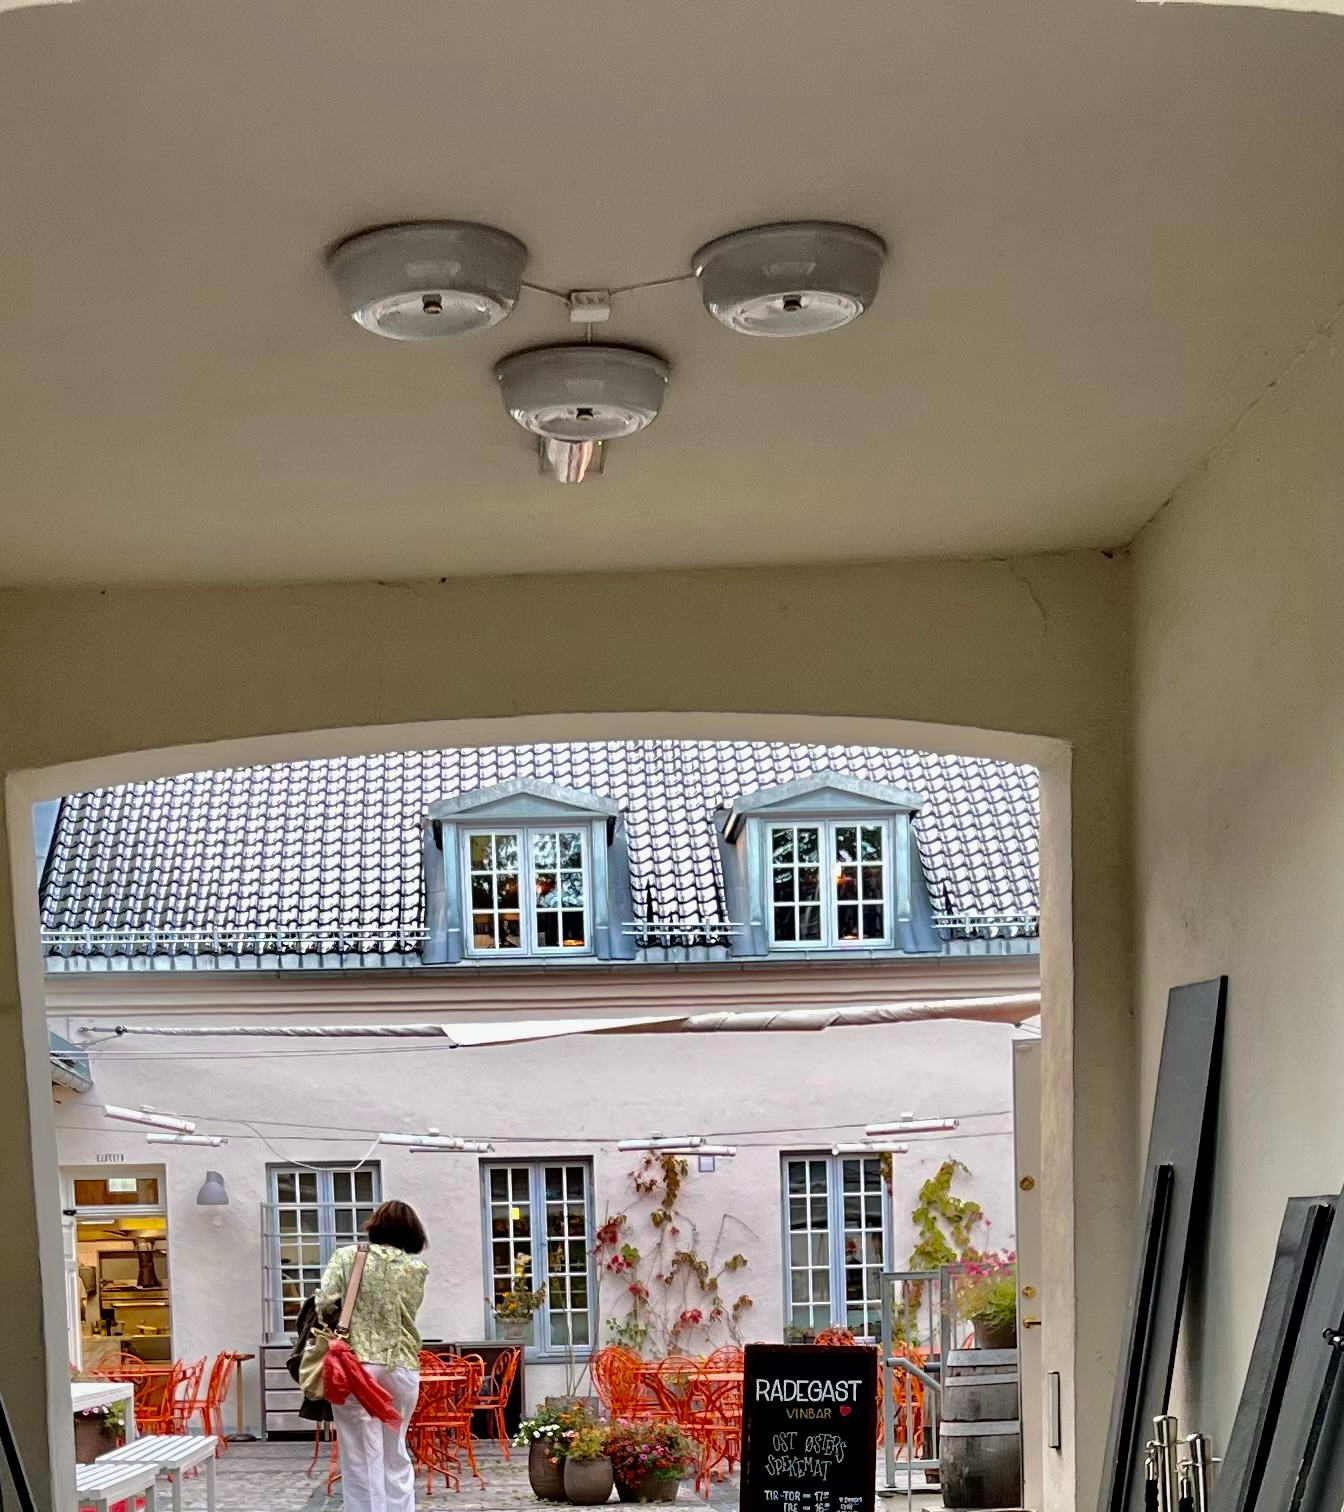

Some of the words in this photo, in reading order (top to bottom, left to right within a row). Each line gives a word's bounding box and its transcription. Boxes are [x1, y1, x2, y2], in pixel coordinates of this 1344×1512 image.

[756, 1379, 862, 1402] RADEGAST
[786, 1407, 832, 1420] VINBAR
[772, 1431, 798, 1452] OST
[805, 1433, 848, 1463] ØSTERS
[764, 1454, 833, 1481] SPEKEMAT
